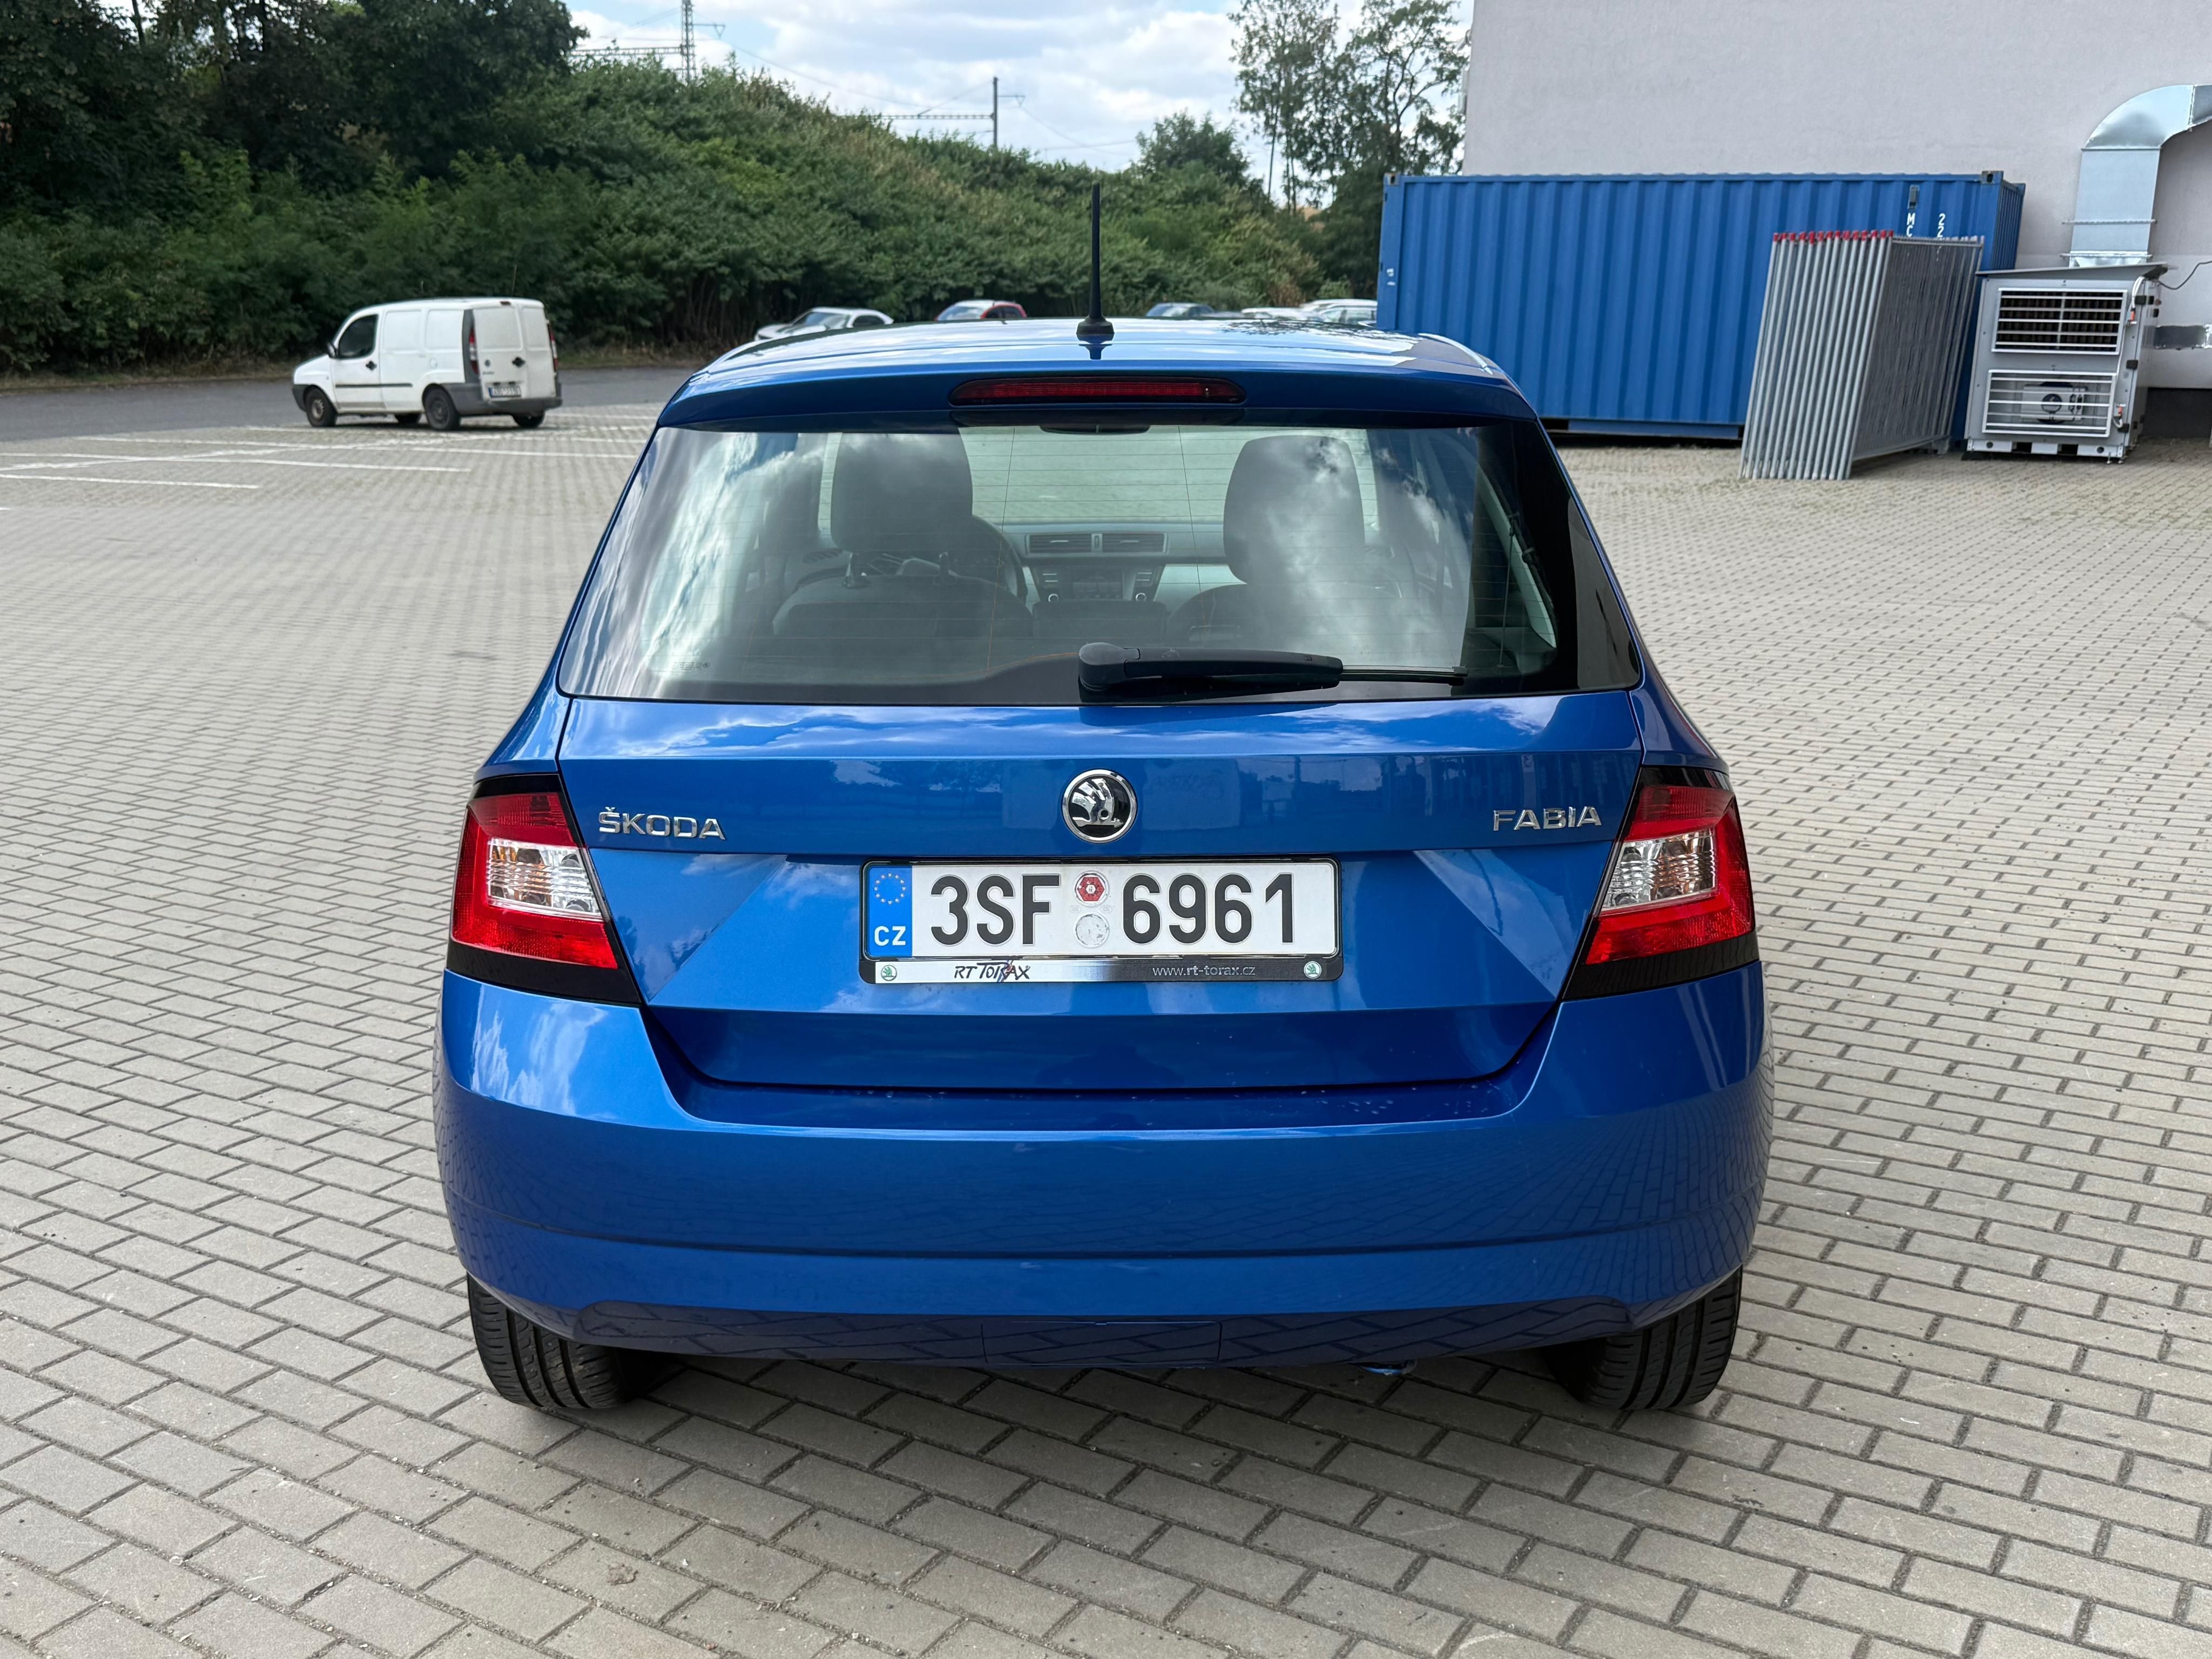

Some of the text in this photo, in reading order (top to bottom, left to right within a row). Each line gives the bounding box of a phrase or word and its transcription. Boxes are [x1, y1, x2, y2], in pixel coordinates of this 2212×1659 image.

[598, 806, 726, 840] ŠKODA
[1493, 806, 1602, 831] FABIA
[930, 873, 1293, 946] 3SF 6961
[874, 926, 906, 946] CZ
[954, 966, 977, 979] RT
[1152, 965, 1256, 976] www.rt-torax.cz
